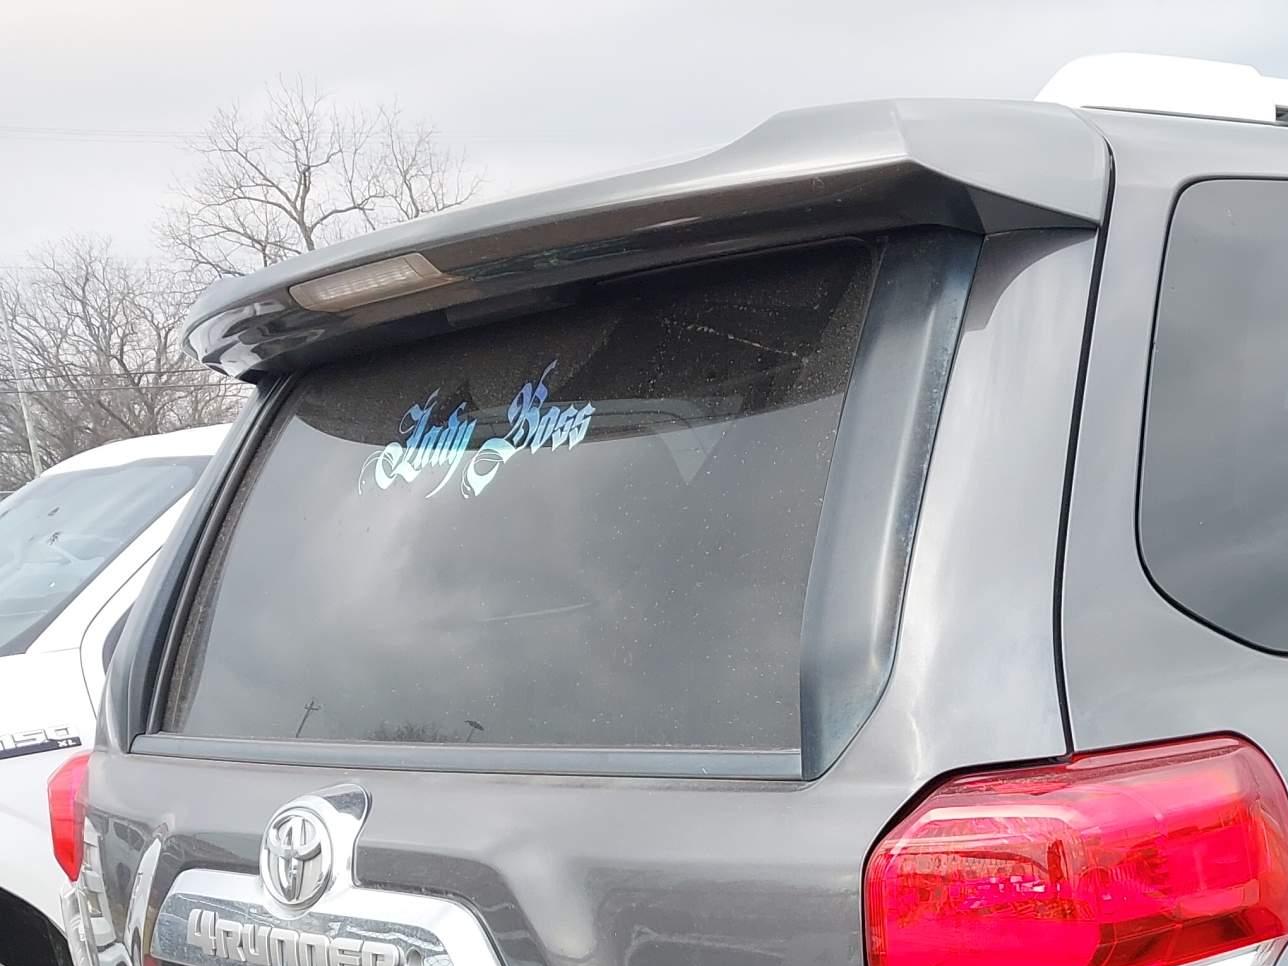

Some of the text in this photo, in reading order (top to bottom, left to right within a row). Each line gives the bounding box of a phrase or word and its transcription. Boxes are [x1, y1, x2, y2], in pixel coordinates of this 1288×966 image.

[359, 359, 596, 498] Lady Boss
[57, 738, 77, 748] XL
